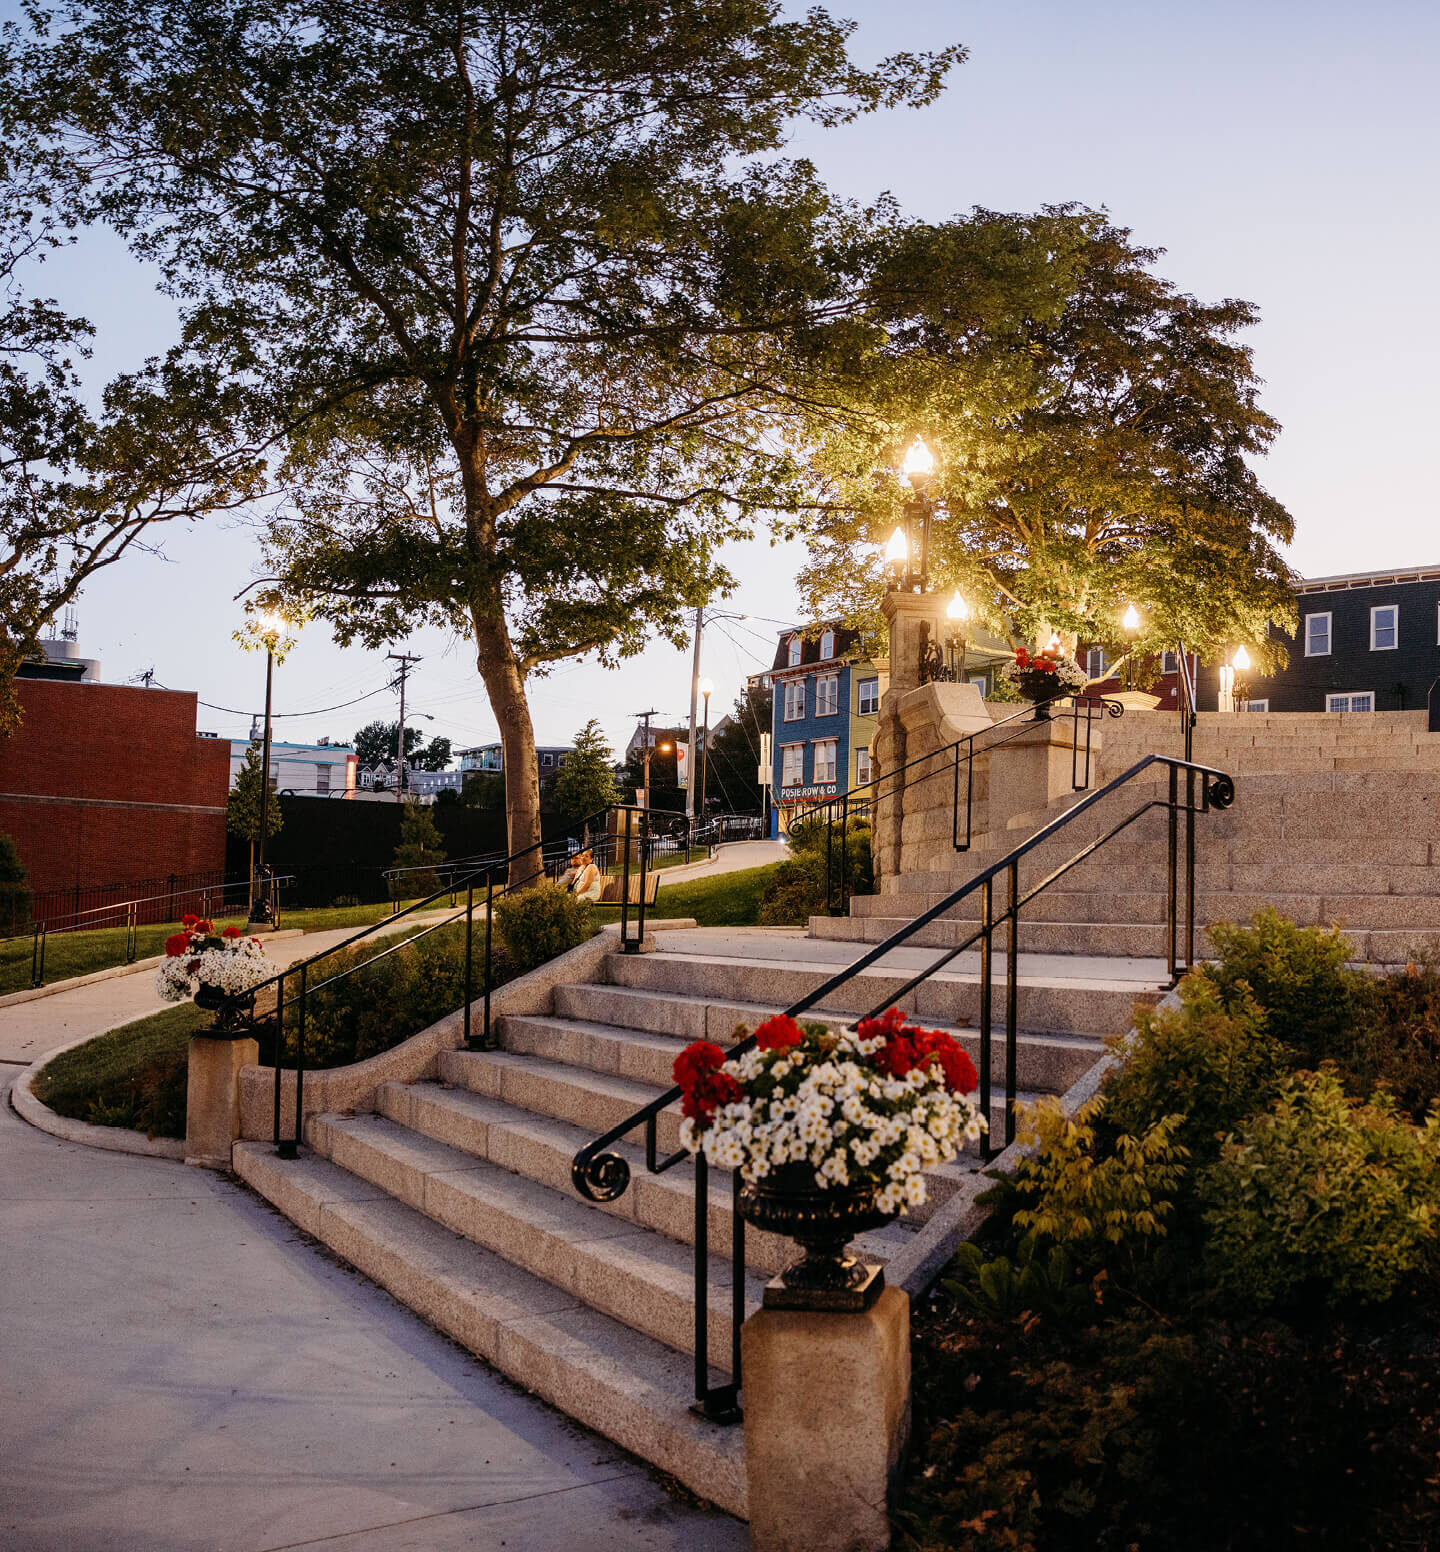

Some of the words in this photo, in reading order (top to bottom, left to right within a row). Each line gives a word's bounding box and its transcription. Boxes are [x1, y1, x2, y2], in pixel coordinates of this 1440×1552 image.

[781, 788, 801, 798] POSIE
[802, 786, 819, 797] ROW
[826, 784, 837, 794] CO
